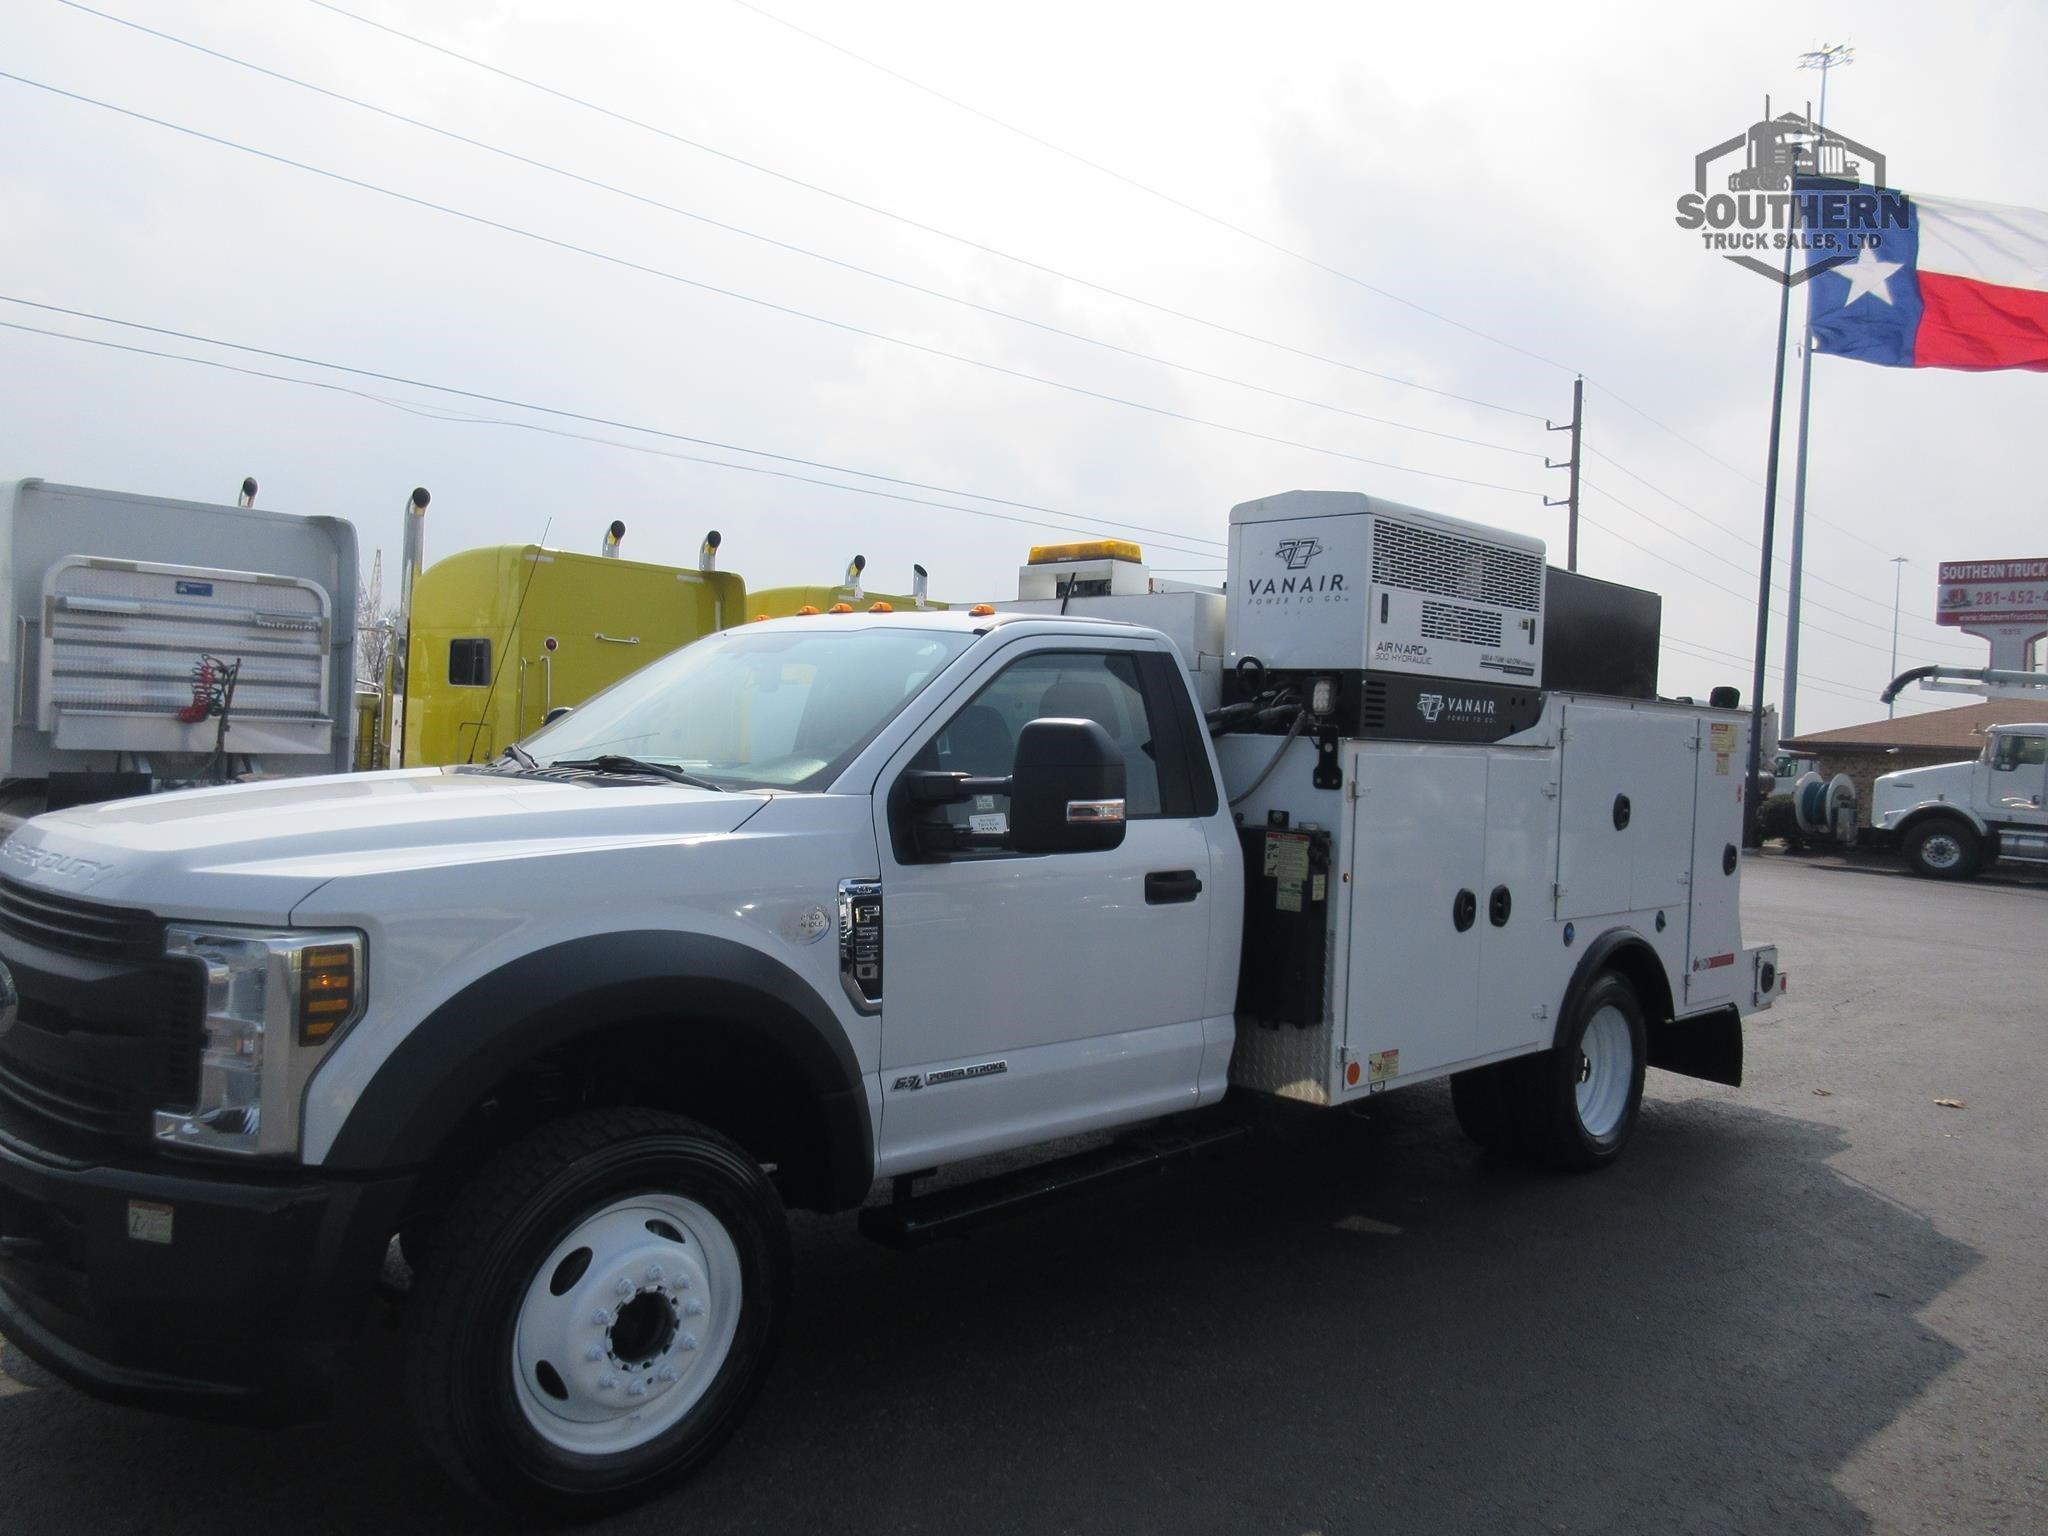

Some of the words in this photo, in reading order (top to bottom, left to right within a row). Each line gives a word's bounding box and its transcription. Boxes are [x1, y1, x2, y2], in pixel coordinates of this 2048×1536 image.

[1942, 564, 2005, 580] SOUTHERN
[1248, 574, 1344, 595] VANAIR
[1448, 697, 1496, 714] VANAIR
[928, 1068, 965, 1081] POWER
[966, 1061, 1006, 1075] STROKE
